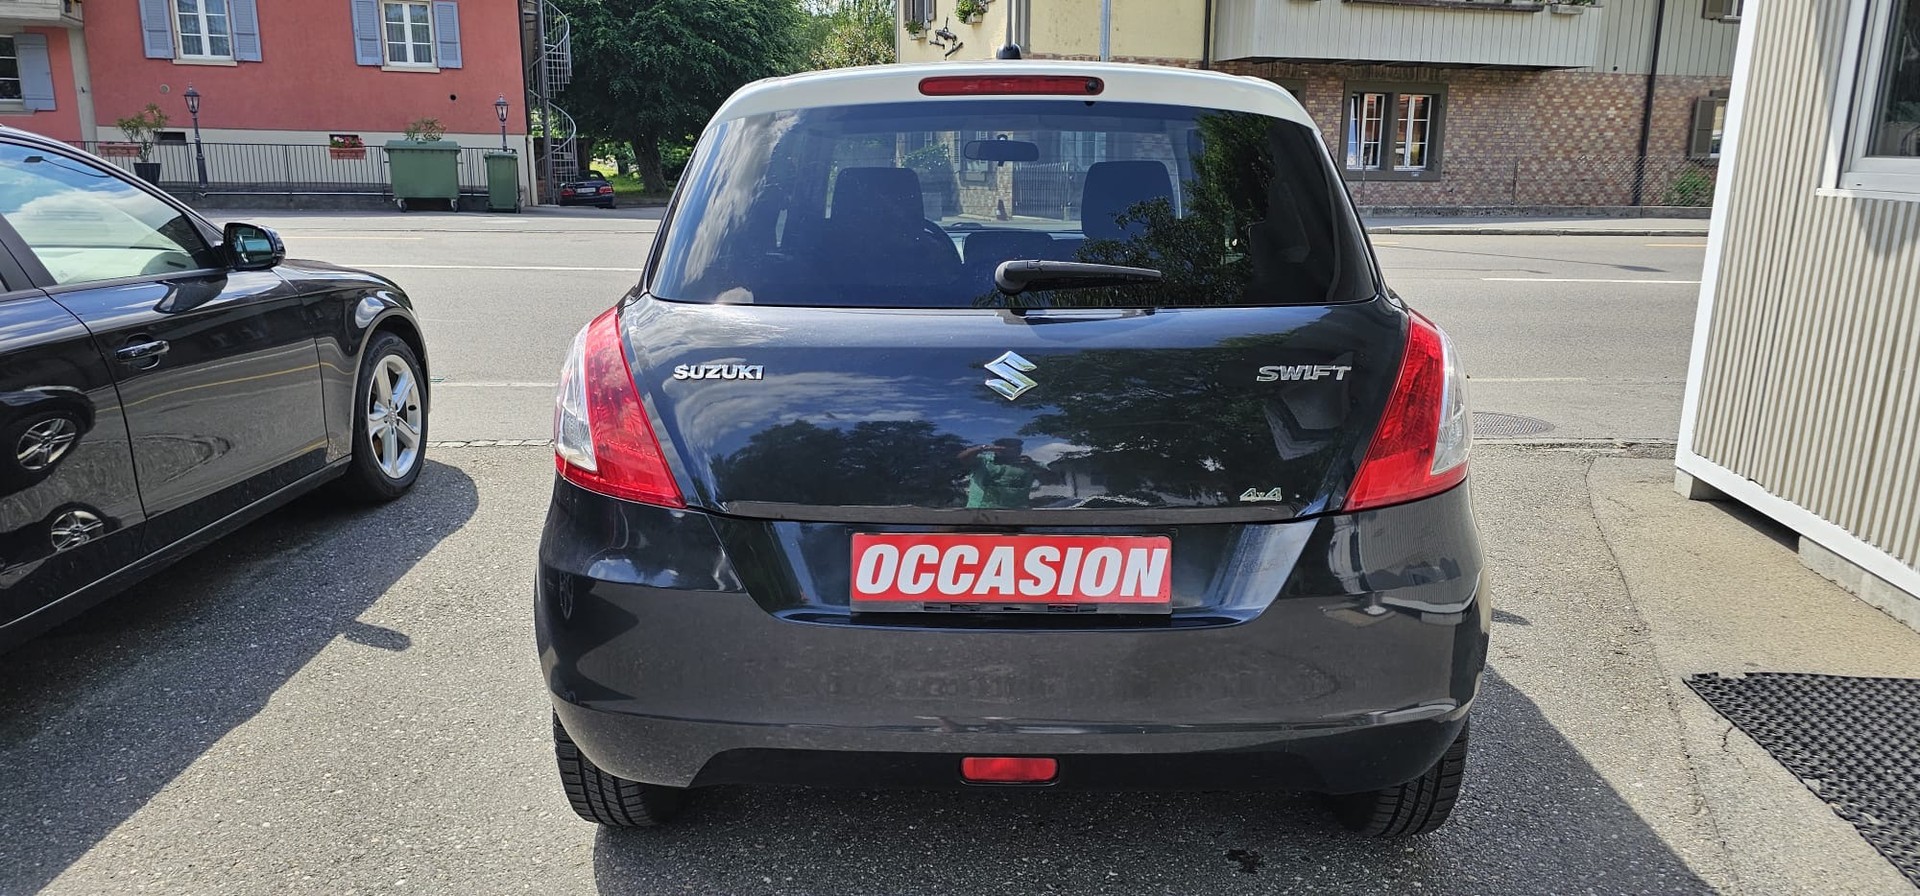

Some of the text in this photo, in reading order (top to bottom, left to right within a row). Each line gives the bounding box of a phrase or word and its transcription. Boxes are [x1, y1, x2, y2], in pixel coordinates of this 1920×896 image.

[673, 364, 764, 380] SUZUKI
[1256, 365, 1352, 381] SWIFT
[855, 544, 1168, 597] OCCASION
